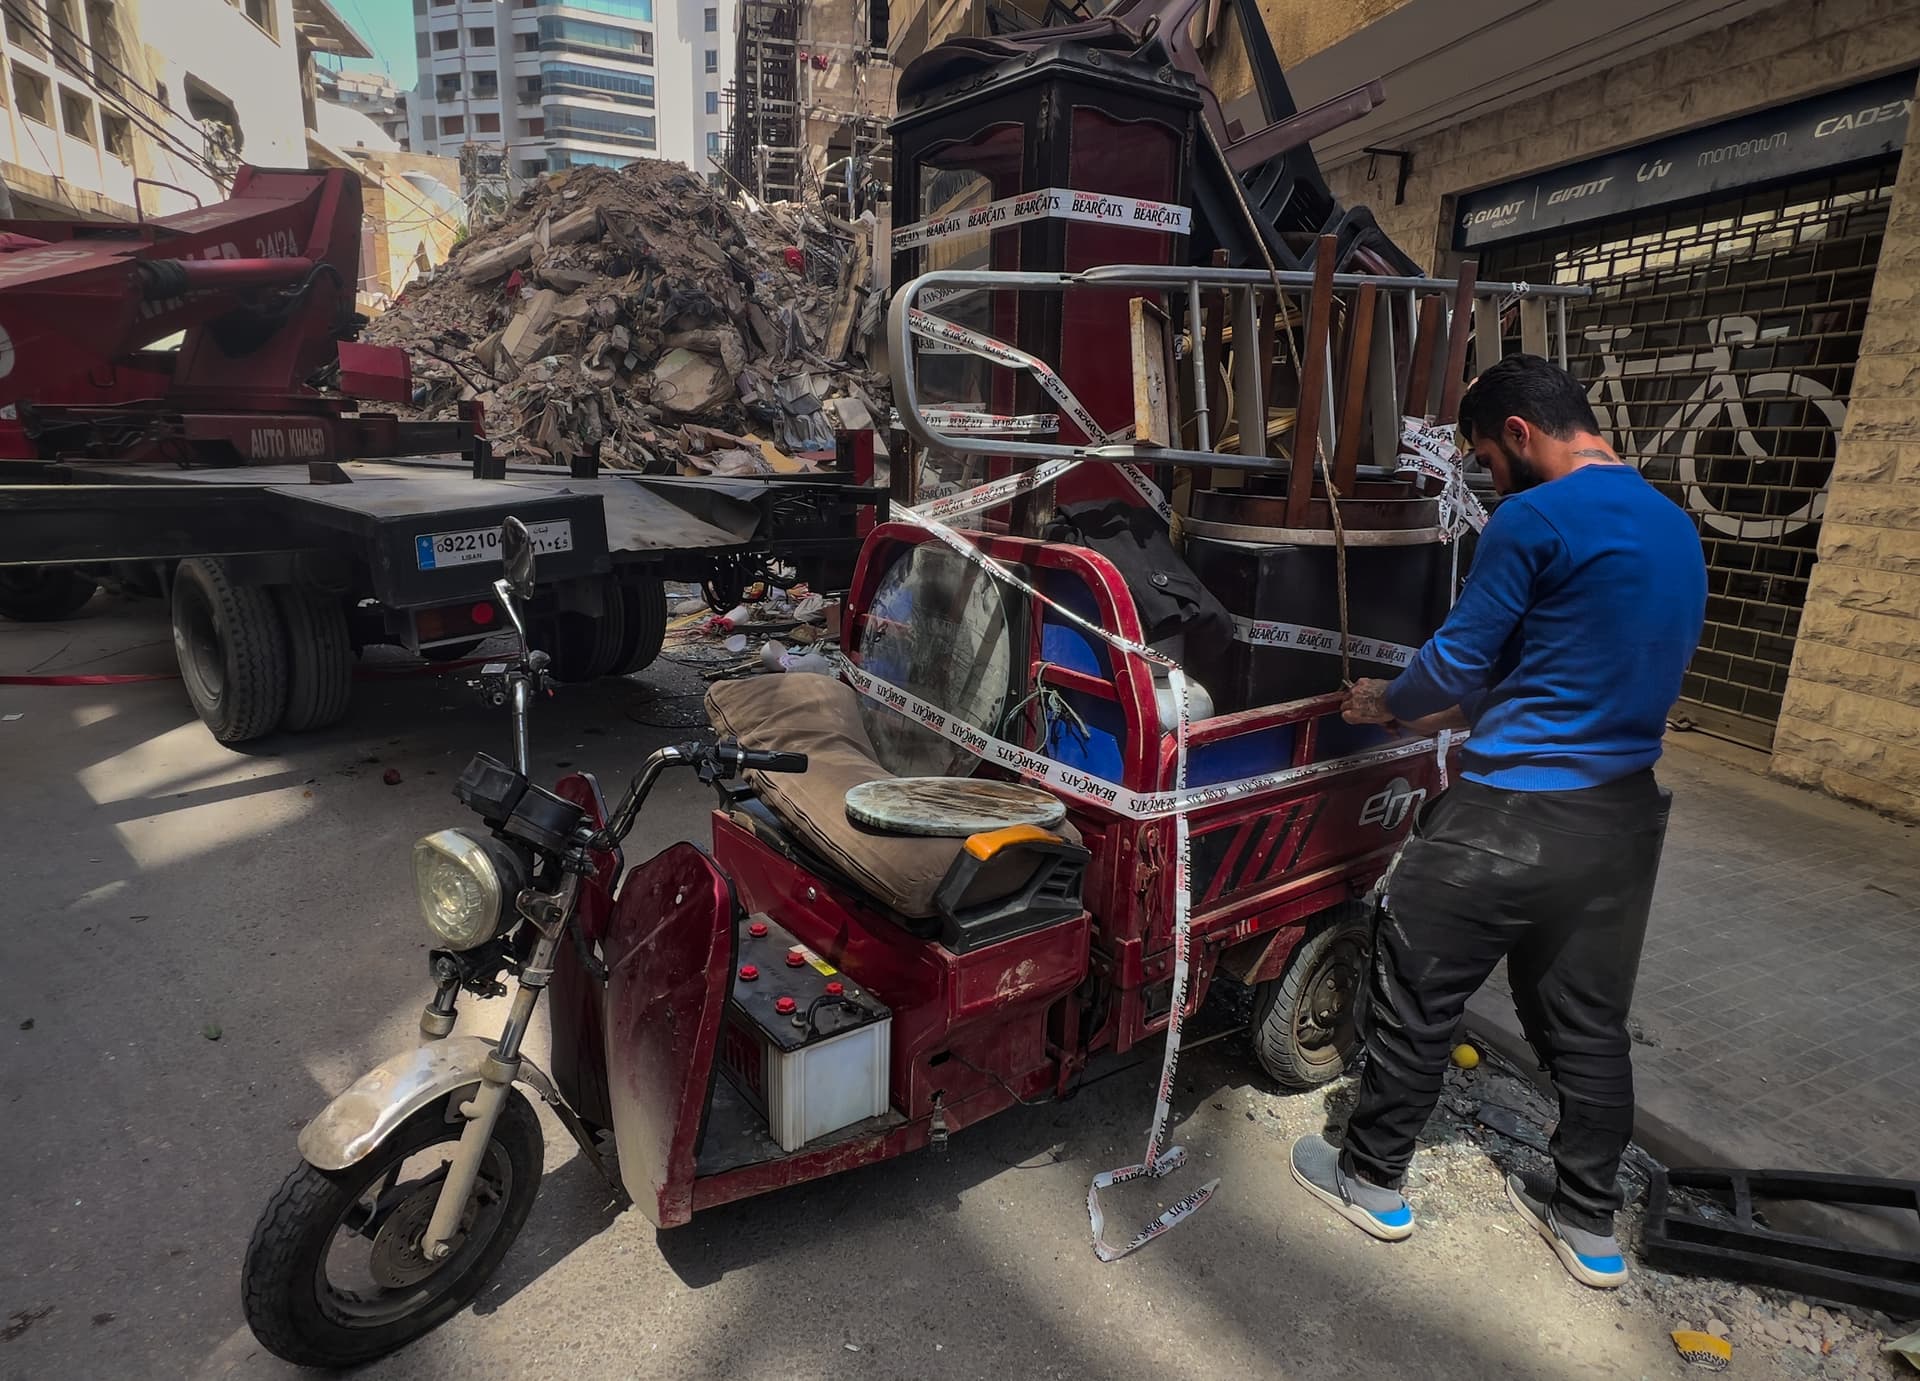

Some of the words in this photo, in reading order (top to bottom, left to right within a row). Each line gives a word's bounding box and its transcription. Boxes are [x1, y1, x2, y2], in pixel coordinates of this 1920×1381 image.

[1814, 99, 1915, 138] CADEX
[1697, 131, 1788, 167] momentum
[1547, 176, 1615, 205] GIANT
[967, 207, 1006, 227] BEARCATS
[1014, 195, 1061, 216] BEARCATS
[1072, 199, 1123, 218] BEARCATS
[1134, 207, 1182, 226] BEARCATS
[1474, 200, 1525, 224] GIANT
[926, 218, 961, 237] BEARCATS
[251, 428, 285, 458] AUTO
[288, 428, 326, 457] KHALED
[1249, 625, 1290, 644] BEARCATS
[1296, 632, 1334, 650] BEARCATS
[1376, 645, 1406, 663] BEARCATS
[876, 685, 907, 708] BEARCATS
[911, 701, 945, 729] BEARCATS
[950, 722, 988, 749] BEARCATS
[995, 746, 1050, 774] BEARCATS
[1060, 770, 1117, 802] BEARCATS
